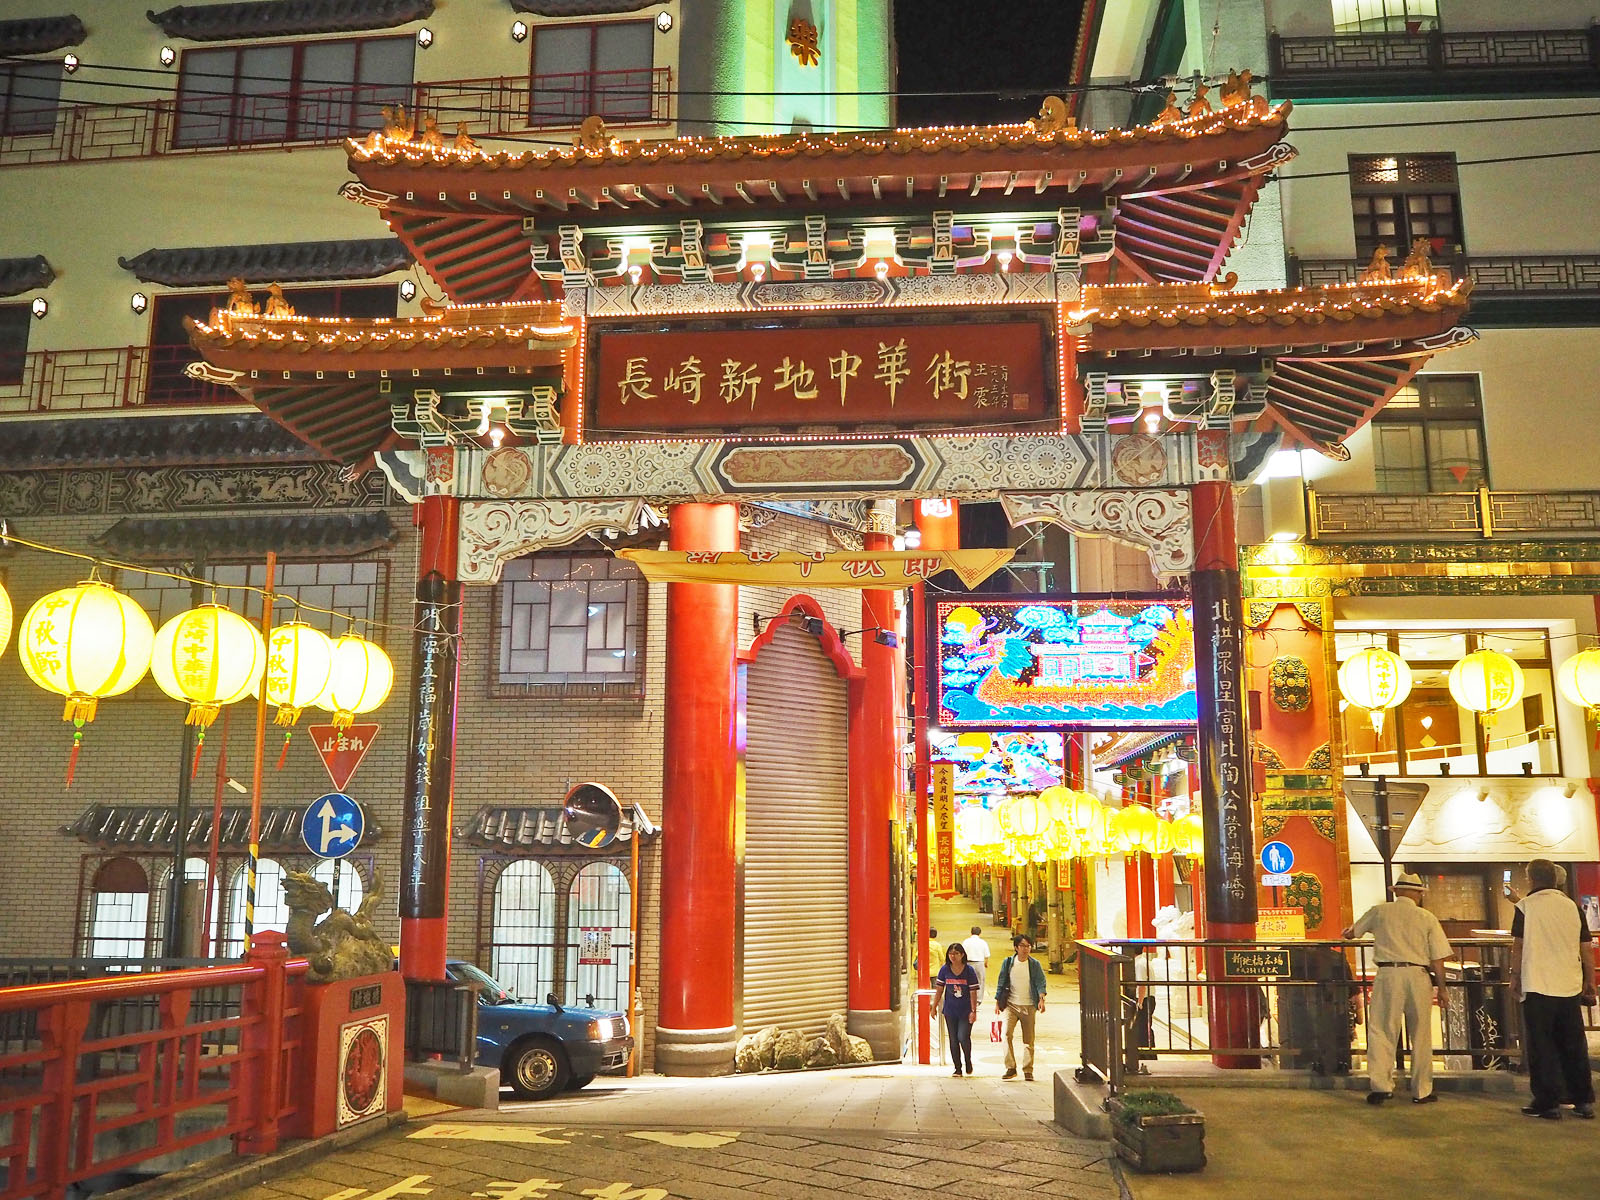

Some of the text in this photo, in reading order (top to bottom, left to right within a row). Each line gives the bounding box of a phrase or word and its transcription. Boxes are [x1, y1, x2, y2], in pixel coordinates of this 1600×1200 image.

[617, 338, 973, 409] 長崎新地中華街
[35, 597, 70, 676] 中秋節
[267, 635, 293, 694] 中秋節
[1492, 658, 1510, 702] 秋節
[321, 736, 365, 752] 止まれ
[938, 836, 951, 886] 長崎中秋節
[1256, 920, 1287, 932] 秋節
